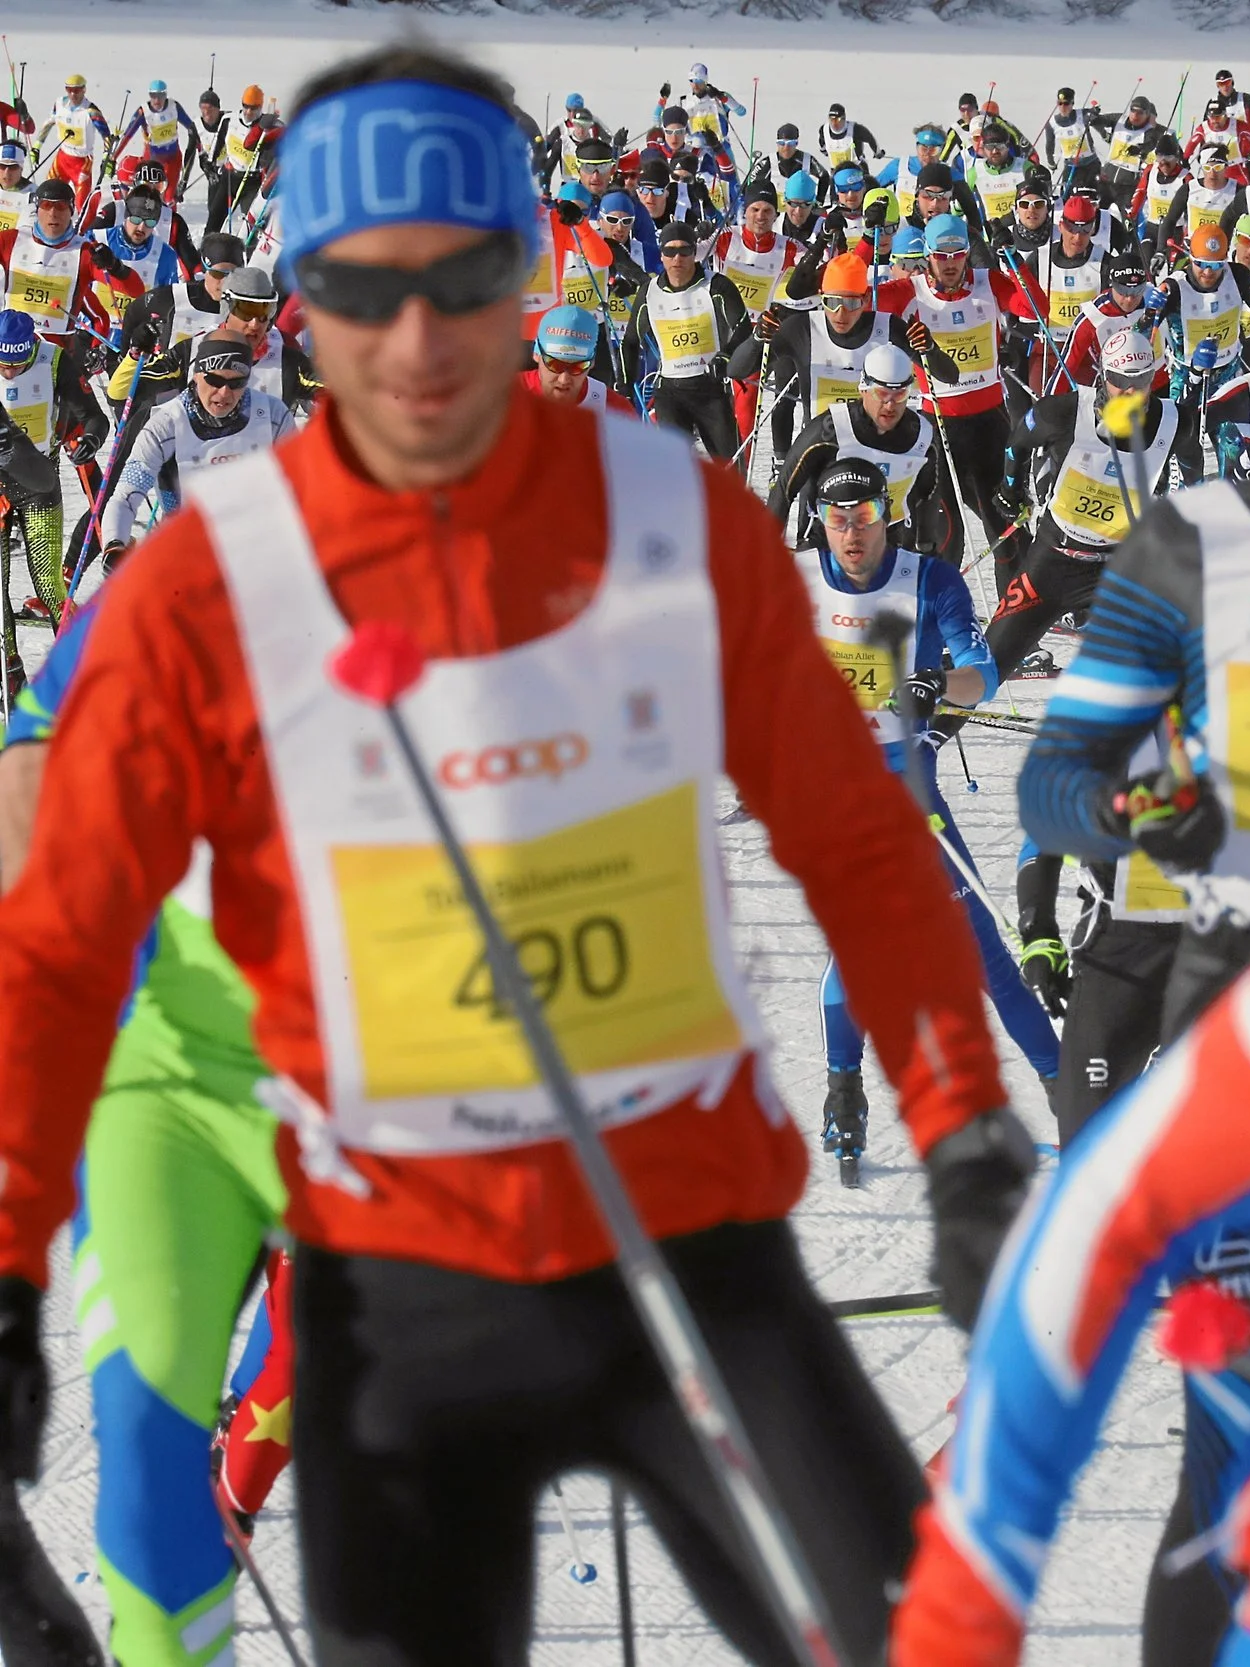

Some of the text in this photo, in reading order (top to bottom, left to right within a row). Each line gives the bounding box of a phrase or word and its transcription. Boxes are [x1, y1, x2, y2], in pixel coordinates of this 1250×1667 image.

[24, 287, 50, 305] 531
[568, 288, 594, 304] 807
[1058, 305, 1081, 317] 410
[672, 331, 700, 348] 693
[947, 345, 980, 362] 764
[673, 361, 699, 370] helvetia
[1075, 495, 1116, 521] 326
[831, 614, 875, 629] coop
[854, 651, 875, 661] Allet
[841, 667, 878, 691] 24
[436, 730, 590, 791] coop
[450, 914, 630, 1022] 490
